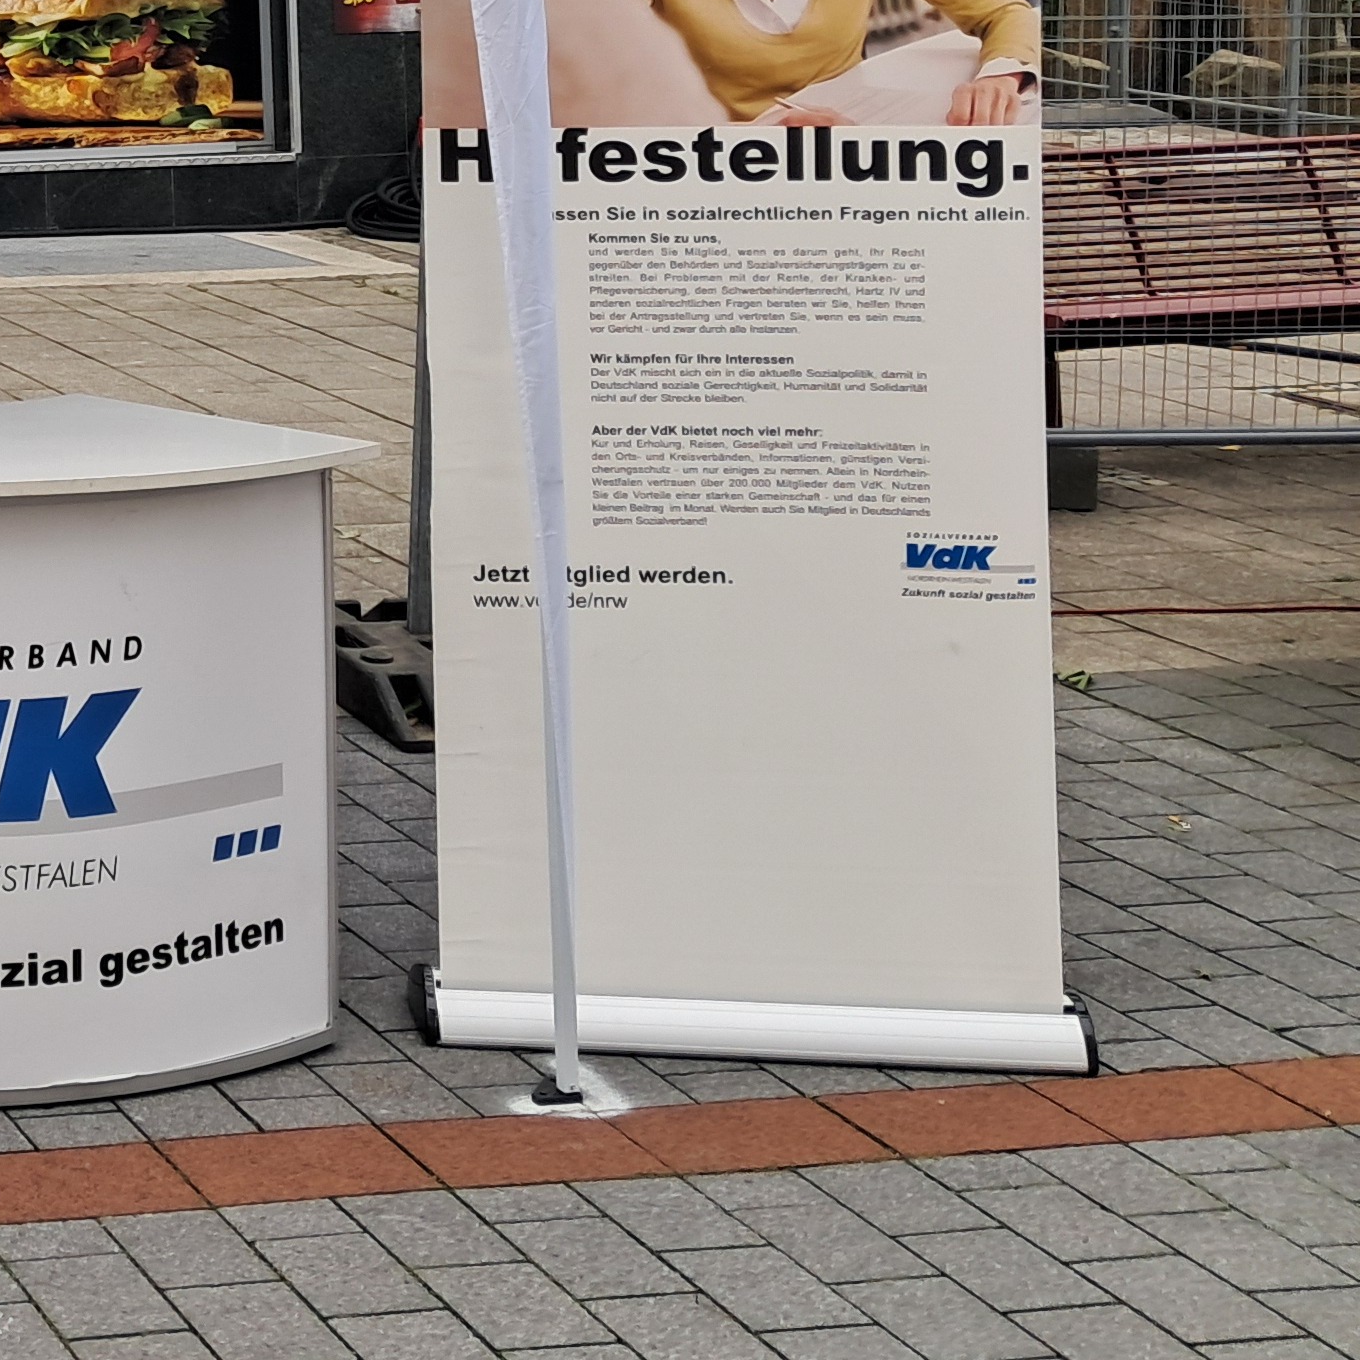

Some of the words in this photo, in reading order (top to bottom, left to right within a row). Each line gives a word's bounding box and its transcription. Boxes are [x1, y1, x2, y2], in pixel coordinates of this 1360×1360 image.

[440, 127, 1029, 197] Hfestellung.
[552, 207, 599, 221] ssen
[607, 206, 636, 221] Sie
[643, 206, 659, 221] in
[667, 206, 832, 221] sozialrechtlichen
[840, 206, 909, 224] Fragen
[917, 206, 968, 221] nicht
[974, 206, 1030, 221] allein.
[589, 233, 646, 243] Kommen
[650, 233, 670, 243] Sie
[694, 236, 721, 244] uns,
[590, 354, 612, 364] Wir
[616, 354, 670, 366] kämpfen
[676, 354, 693, 364] für
[697, 354, 721, 364] Ihre
[726, 354, 794, 364] Interessen
[592, 425, 622, 435] Aber
[626, 425, 646, 435] der
[651, 425, 677, 436] VdK
[682, 426, 717, 436] bietet
[722, 426, 753, 436] noch
[758, 426, 780, 436] viel
[785, 427, 822, 437] mehr:
[906, 532, 999, 541] SOZIALVERBAND
[906, 543, 997, 570] VdK
[473, 565, 529, 582] Jetzt
[566, 565, 630, 586] tglied
[638, 566, 734, 584] werden.
[902, 587, 945, 598] Zukunft
[949, 590, 983, 599] sozial
[985, 591, 1036, 602] gestalten
[99, 917, 285, 987] gestalten
